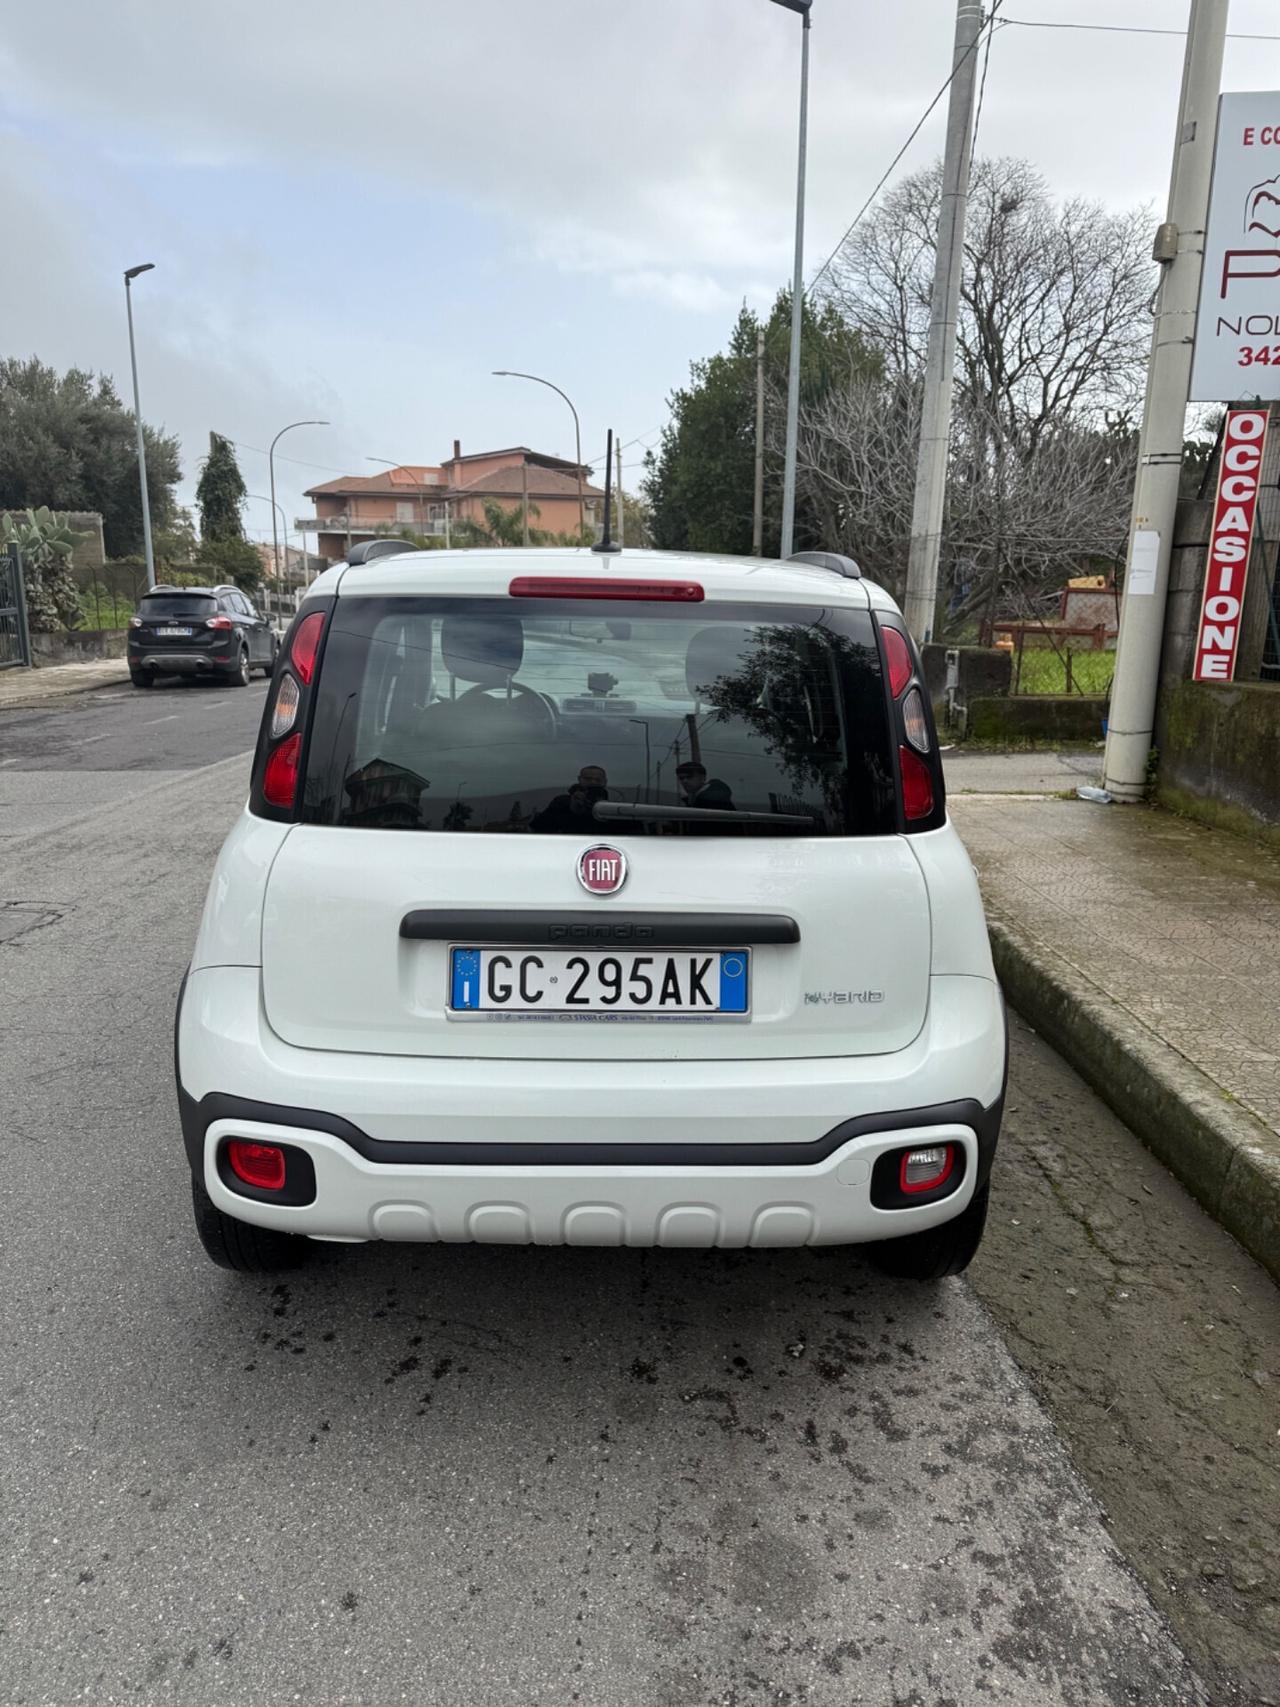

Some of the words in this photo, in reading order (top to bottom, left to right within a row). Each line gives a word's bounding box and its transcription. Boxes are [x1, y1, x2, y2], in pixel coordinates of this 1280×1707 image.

[1243, 127, 1255, 146] E
[1200, 413, 1265, 679] OCCASIONE
[588, 859, 618, 881] FIAT
[487, 955, 545, 1004] GC
[565, 956, 714, 1006] 295AK
